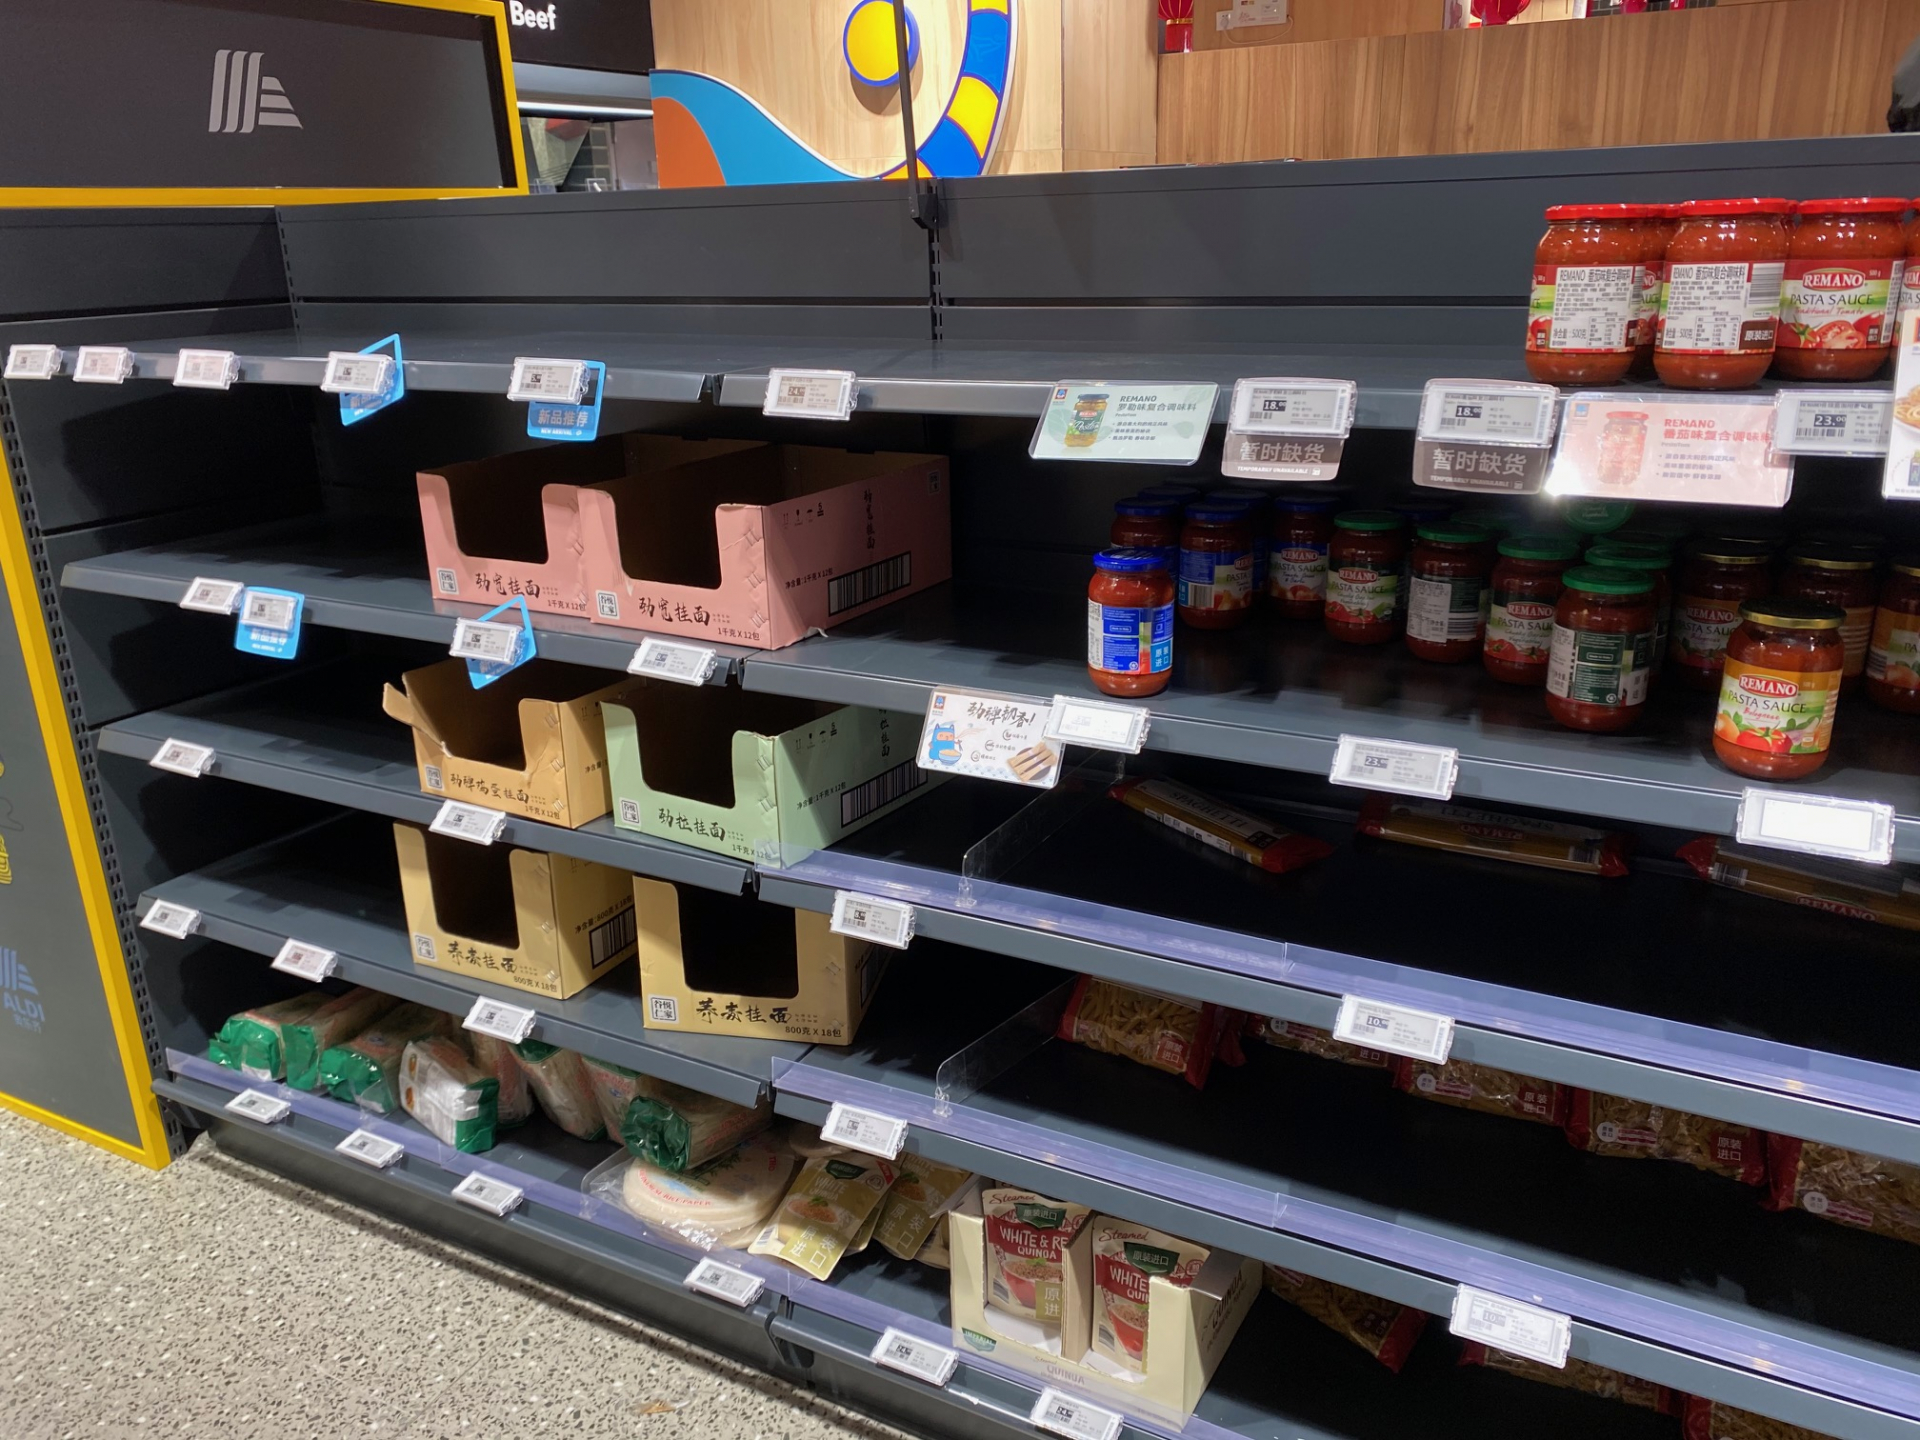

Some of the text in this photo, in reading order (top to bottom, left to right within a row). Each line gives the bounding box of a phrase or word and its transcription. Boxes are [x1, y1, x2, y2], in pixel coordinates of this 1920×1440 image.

[509, 1, 556, 30] Beef
[1803, 273, 1863, 288] REMANO
[1790, 293, 1874, 306] PASTA SAUCE
[1837, 306, 1865, 316] Tomato
[1744, 329, 1773, 341] 原装进口
[537, 408, 589, 427] 新品推荐
[1664, 418, 1715, 428] REMANO
[1240, 441, 1326, 464] 暂时缺货
[1433, 448, 1527, 477] 暂时缺货
[1237, 466, 1308, 475] TEMPORARILY UNAVAILABLE
[1430, 475, 1509, 488] TEMPORARILY UNAVAILABLE
[1282, 551, 1318, 561] REMANO
[1298, 564, 1326, 573] SAUCE
[1339, 570, 1377, 581] REMANO
[1331, 581, 1385, 594] PASTA SAUCE
[1508, 604, 1553, 617] REMANO
[1687, 608, 1734, 622] REMANO
[1498, 617, 1525, 630] PASTA
[1740, 676, 1797, 695] REMANO
[1728, 690, 1807, 714] PASTA SAUCE
[1169, 791, 1249, 829] SPAGHETTI
[1461, 824, 1524, 840] REMANO
[1799, 897, 1876, 921] REMANO
[4, 991, 46, 1022] ALDI
[696, 998, 792, 1024] 荞麦挂面
[1162, 1051, 1181, 1063] 进口
[1360, 1047, 1381, 1060] 进口
[1524, 1091, 1548, 1104] 原装
[1717, 1136, 1743, 1149] 原装
[1717, 1149, 1742, 1161] 进口
[814, 1177, 848, 1194] WHITE
[889, 1203, 927, 1234] 原装
[1023, 1209, 1057, 1221] 原装进口
[800, 1225, 838, 1253] 原装
[882, 1218, 914, 1249] 进口
[999, 1225, 1069, 1251] WHITE & RE
[1098, 1227, 1150, 1243] Steamed
[789, 1240, 826, 1268] 进口
[1017, 1246, 1057, 1260] QUINOA
[1132, 1250, 1169, 1266] 原装进口
[1109, 1265, 1147, 1290] WHITE
